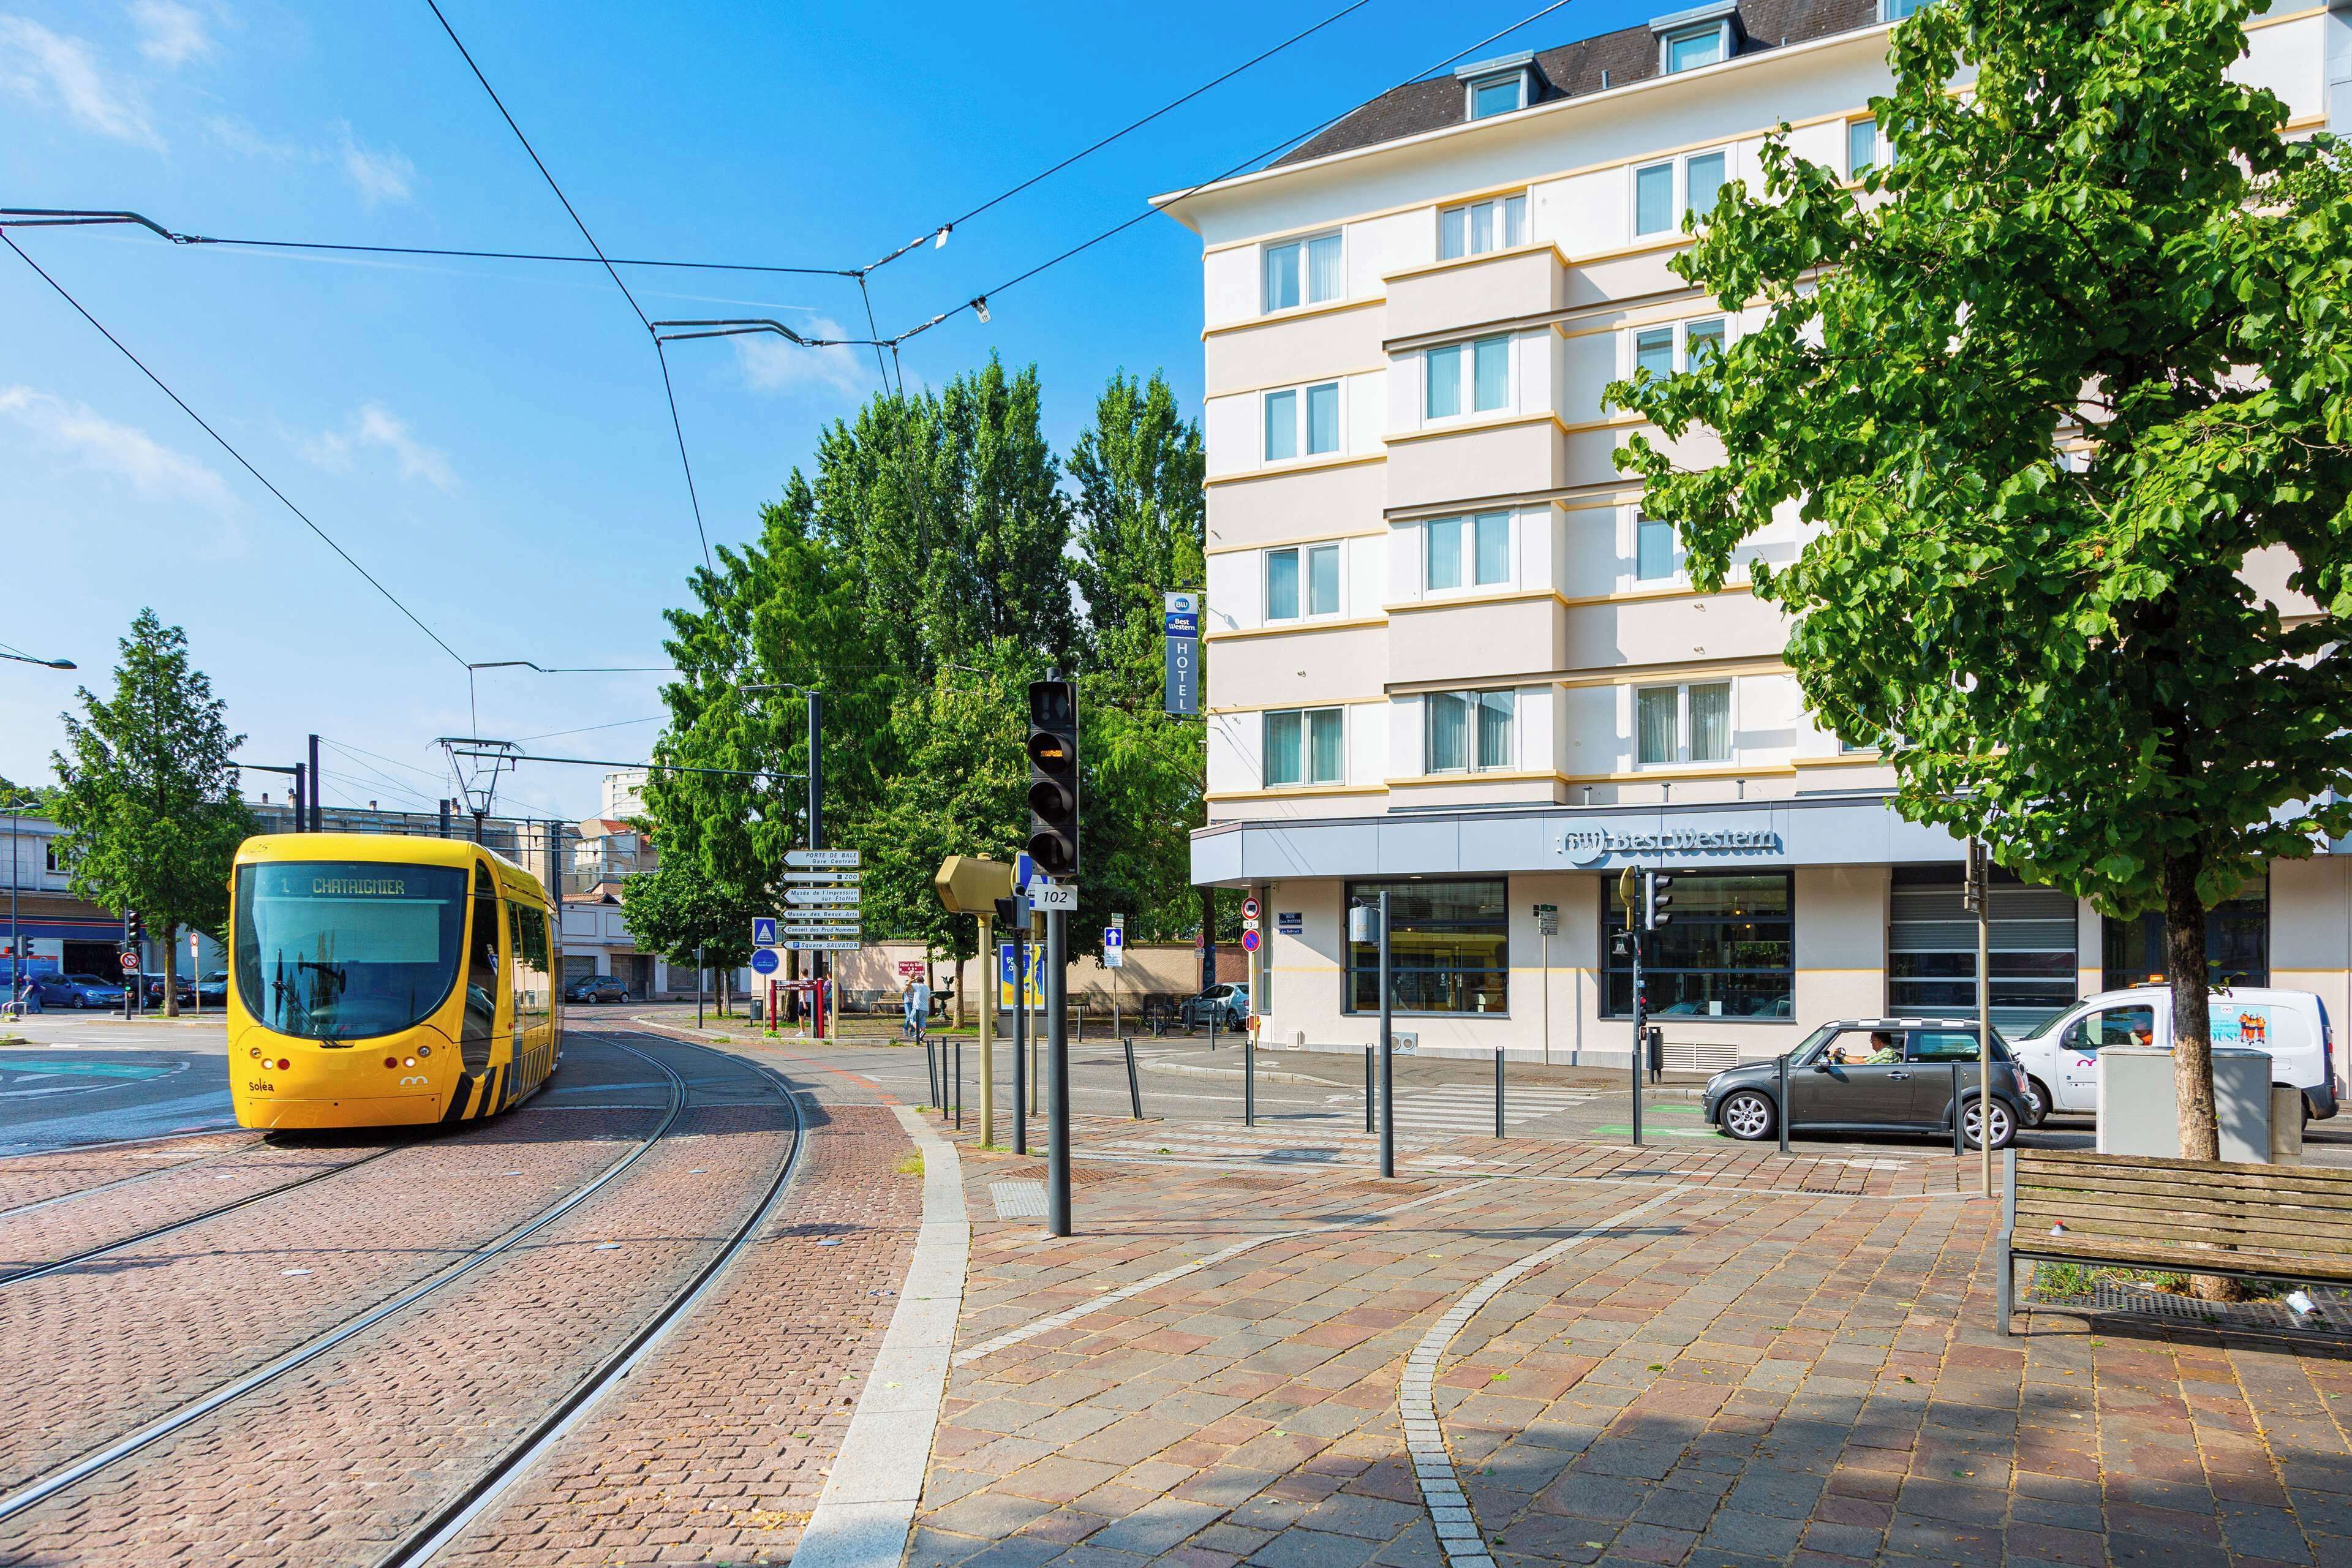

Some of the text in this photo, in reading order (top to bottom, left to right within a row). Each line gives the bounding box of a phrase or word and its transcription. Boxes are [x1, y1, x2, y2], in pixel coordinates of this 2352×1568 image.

[1177, 643, 1188, 710] HOTEL
[1612, 830, 1667, 851] Best
[1672, 827, 1776, 850] Western
[281, 877, 405, 895] 1 CHATAIGNIER
[1044, 891, 1068, 903] 102
[2211, 1032, 2237, 1042] OUS!
